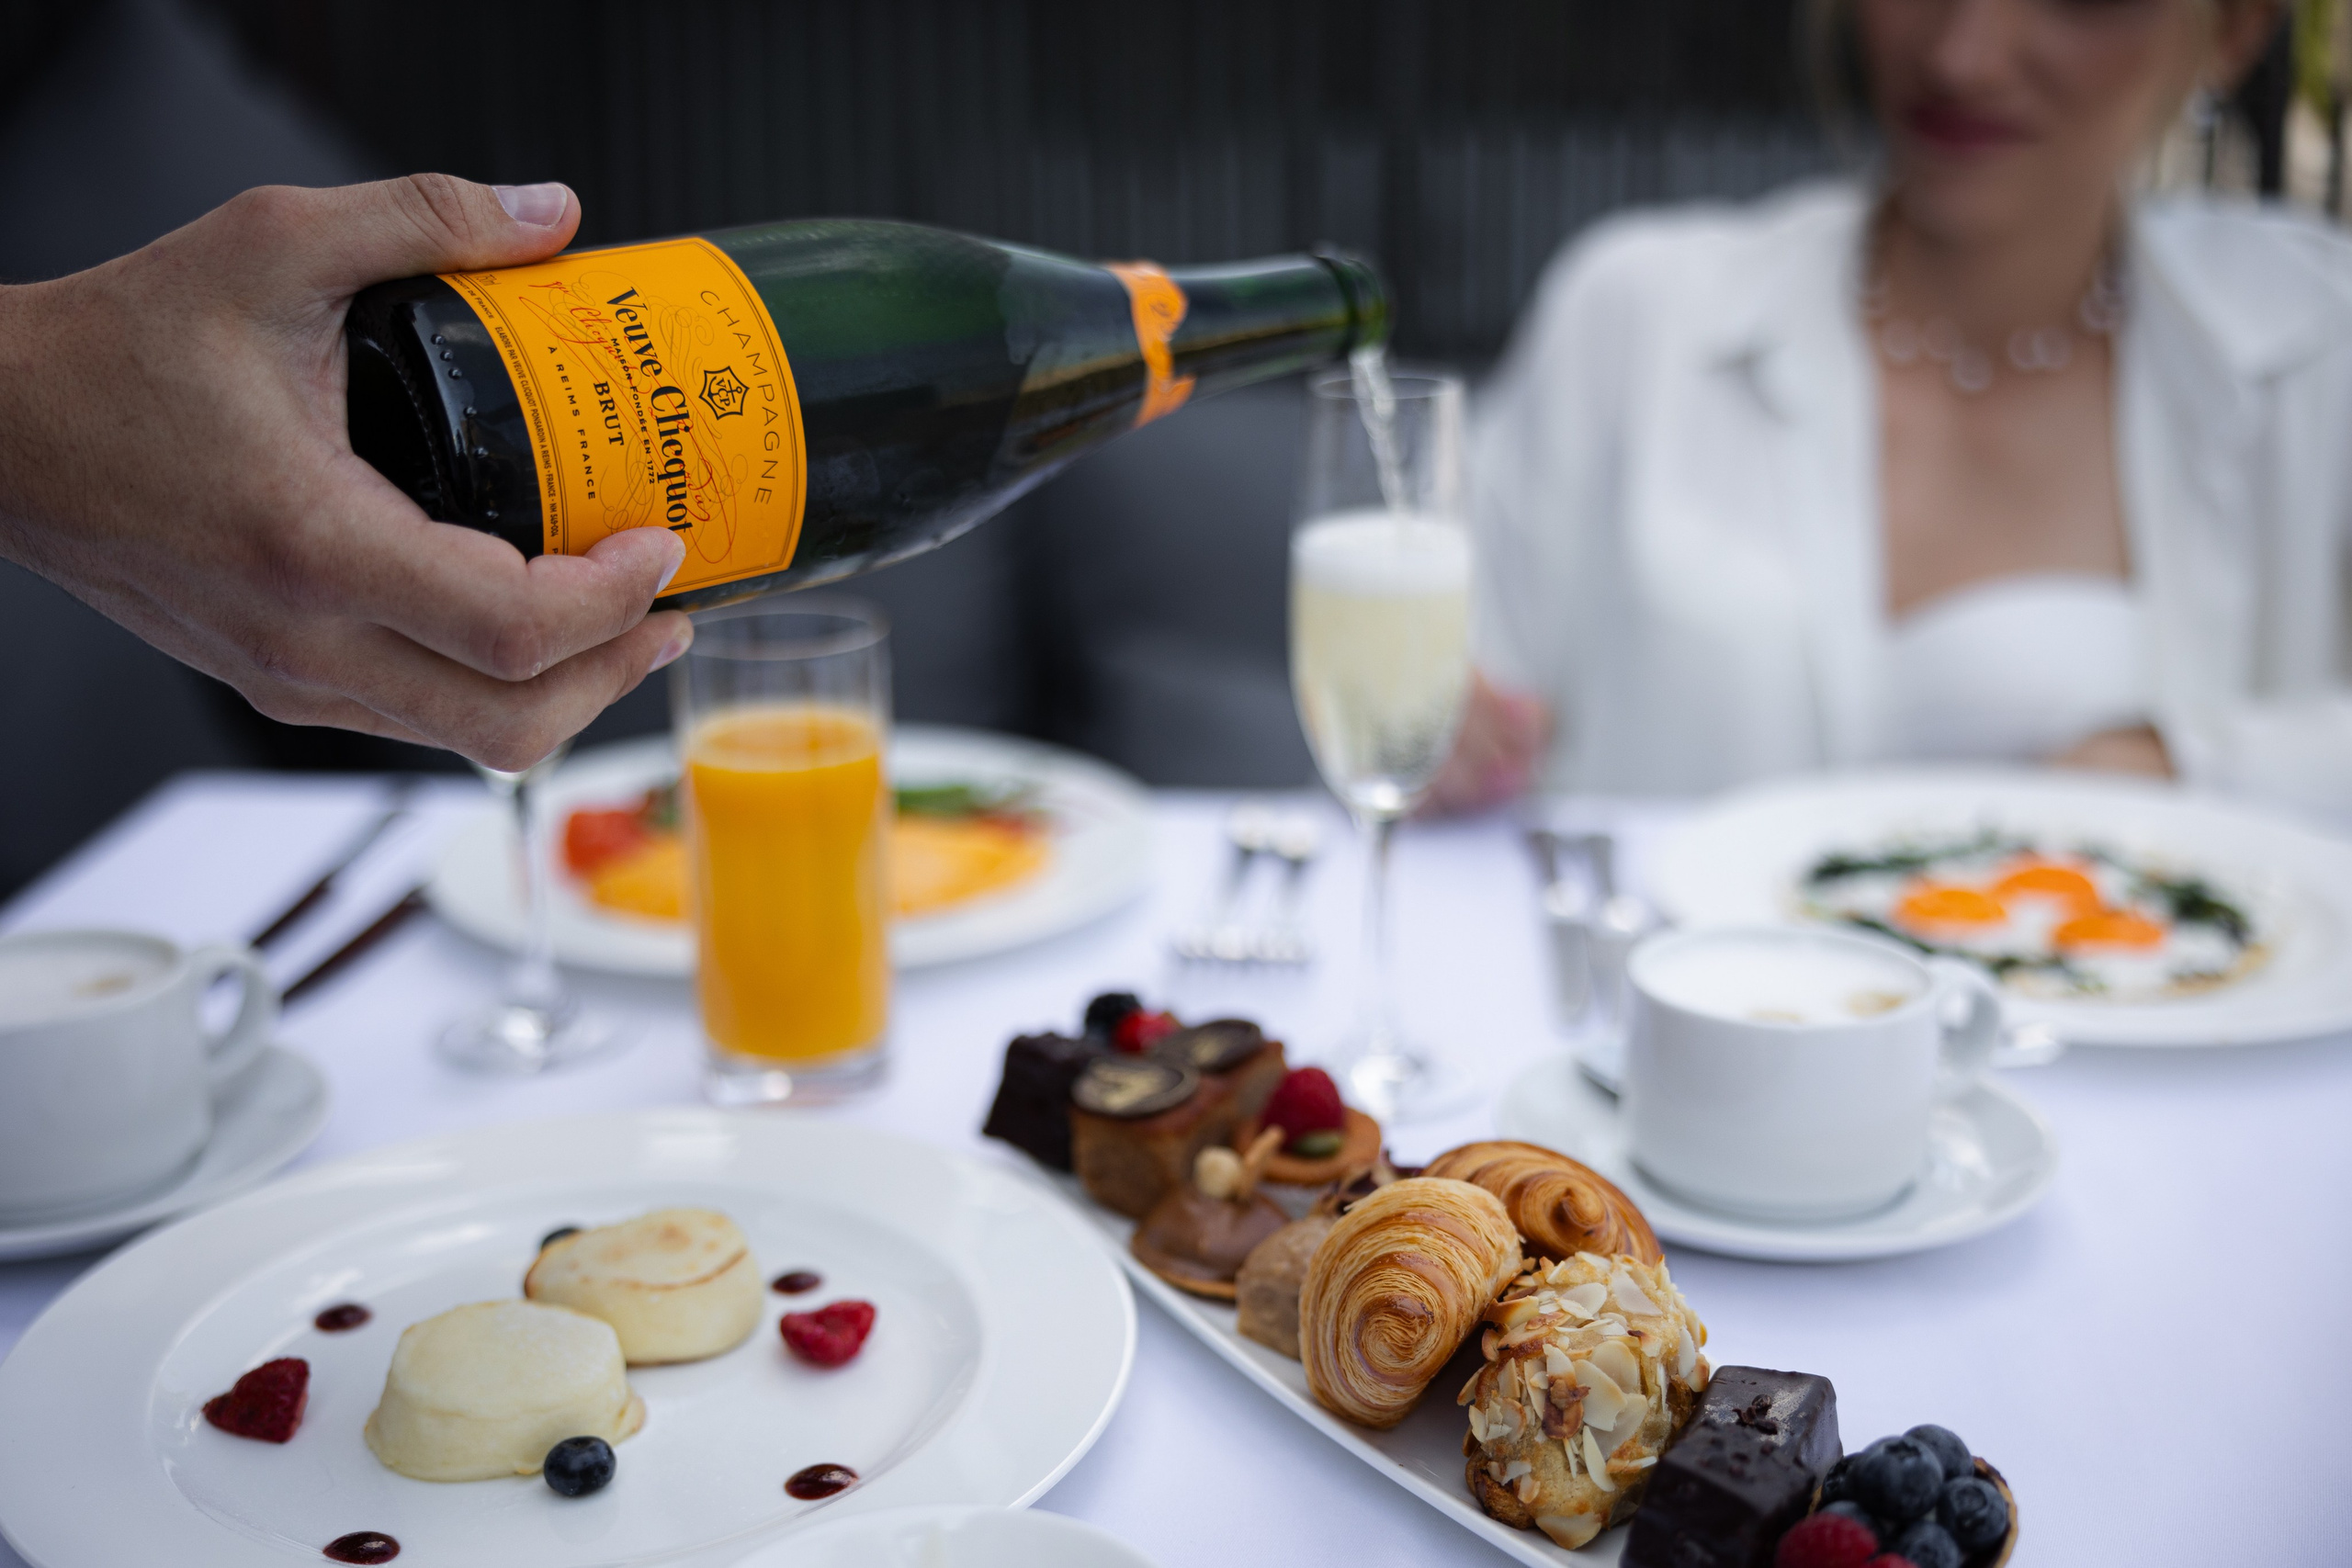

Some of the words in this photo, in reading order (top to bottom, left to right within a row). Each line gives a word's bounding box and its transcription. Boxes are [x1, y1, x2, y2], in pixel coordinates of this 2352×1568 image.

[474, 297, 494, 319] FRANCE
[507, 349, 518, 360] PAR
[513, 360, 526, 379] VEUVE
[520, 379, 537, 408] CLICQUOT
[700, 290, 780, 505] CHAMPAGNE
[715, 377, 731, 407] VCP
[593, 380, 625, 446] BRUT
[606, 286, 662, 378] Veuve
[650, 385, 694, 534] Clicquot
[610, 338, 633, 380] MAISON
[630, 385, 648, 433] FONDÉE
[643, 438, 651, 455] EN
[647, 460, 655, 484] 1772
[530, 408, 547, 444] PONSARDIN
[556, 364, 581, 417] REIMS
[577, 429, 596, 500] FRANCE
[541, 450, 552, 469] REIMS
[546, 473, 556, 498] FRANCE
[549, 502, 558, 513] NM
